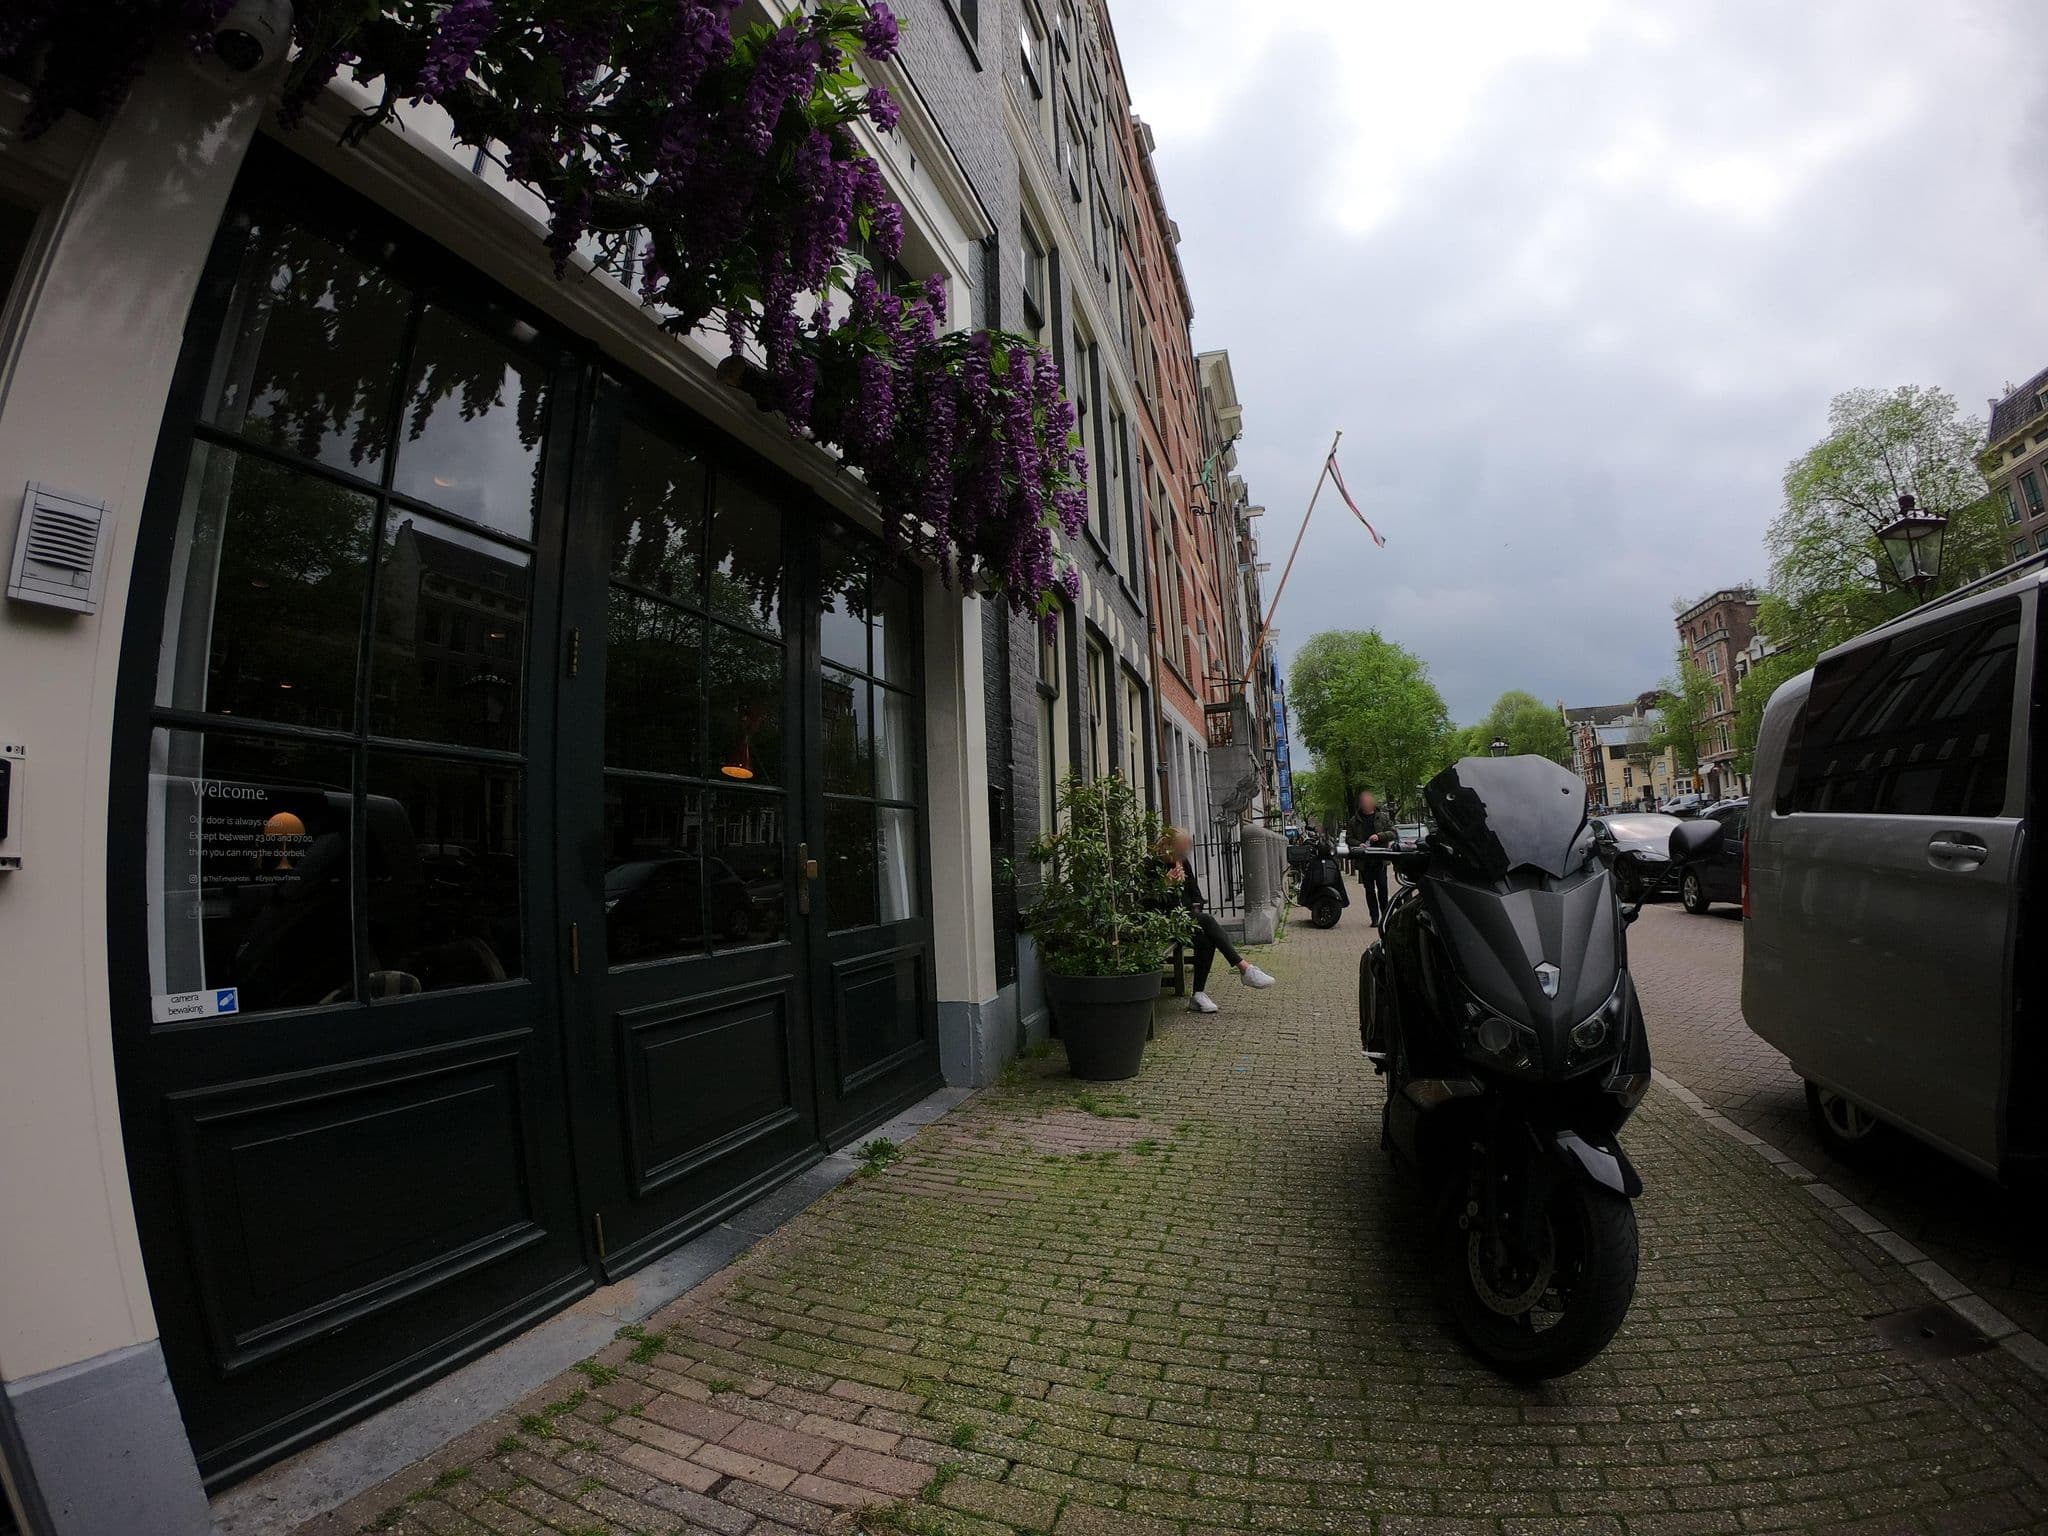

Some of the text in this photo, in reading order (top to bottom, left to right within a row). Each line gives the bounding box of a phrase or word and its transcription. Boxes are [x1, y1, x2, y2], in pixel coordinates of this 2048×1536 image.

[191, 781, 268, 800] Welcome.
[206, 815, 225, 826] door
[226, 816, 234, 826] is
[235, 817, 262, 829] always
[218, 831, 254, 842] between
[277, 834, 292, 843] and
[209, 849, 225, 859] you
[226, 848, 241, 858] can
[242, 848, 258, 860] ring
[258, 848, 273, 858] the
[171, 995, 199, 1003] camera
[168, 1004, 204, 1016] bewaking
